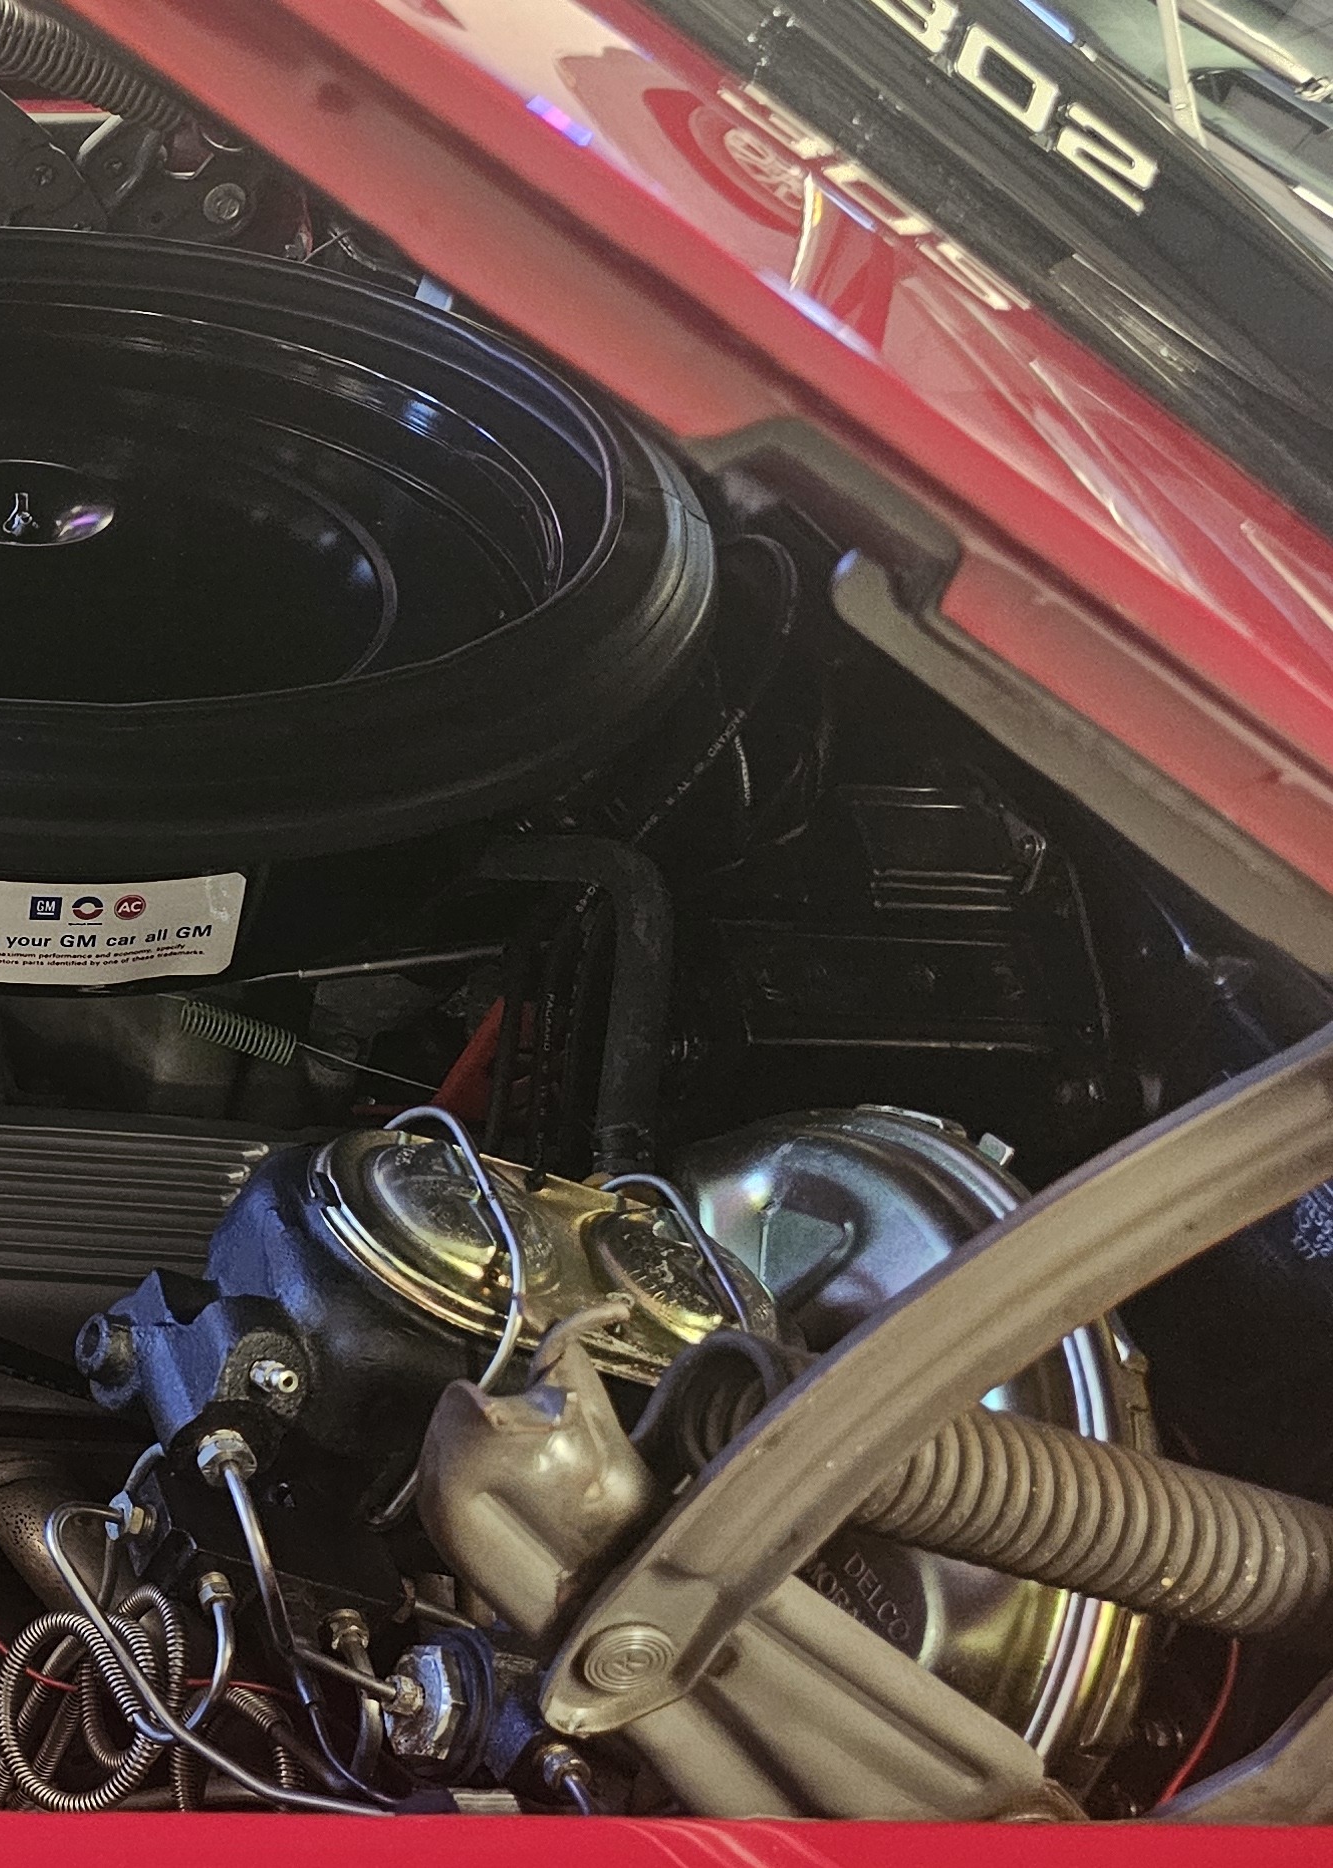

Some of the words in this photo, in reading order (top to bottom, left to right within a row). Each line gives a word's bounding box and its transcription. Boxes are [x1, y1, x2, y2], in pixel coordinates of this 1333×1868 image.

[6, 936, 52, 948] your
[60, 934, 97, 948] GM
[106, 935, 137, 947] car
[145, 929, 168, 943] all
[176, 924, 213, 939] GM
[38, 952, 93, 960] performance
[156, 944, 186, 952] specify
[132, 954, 155, 962] these
[844, 1551, 910, 1641] DELCO
